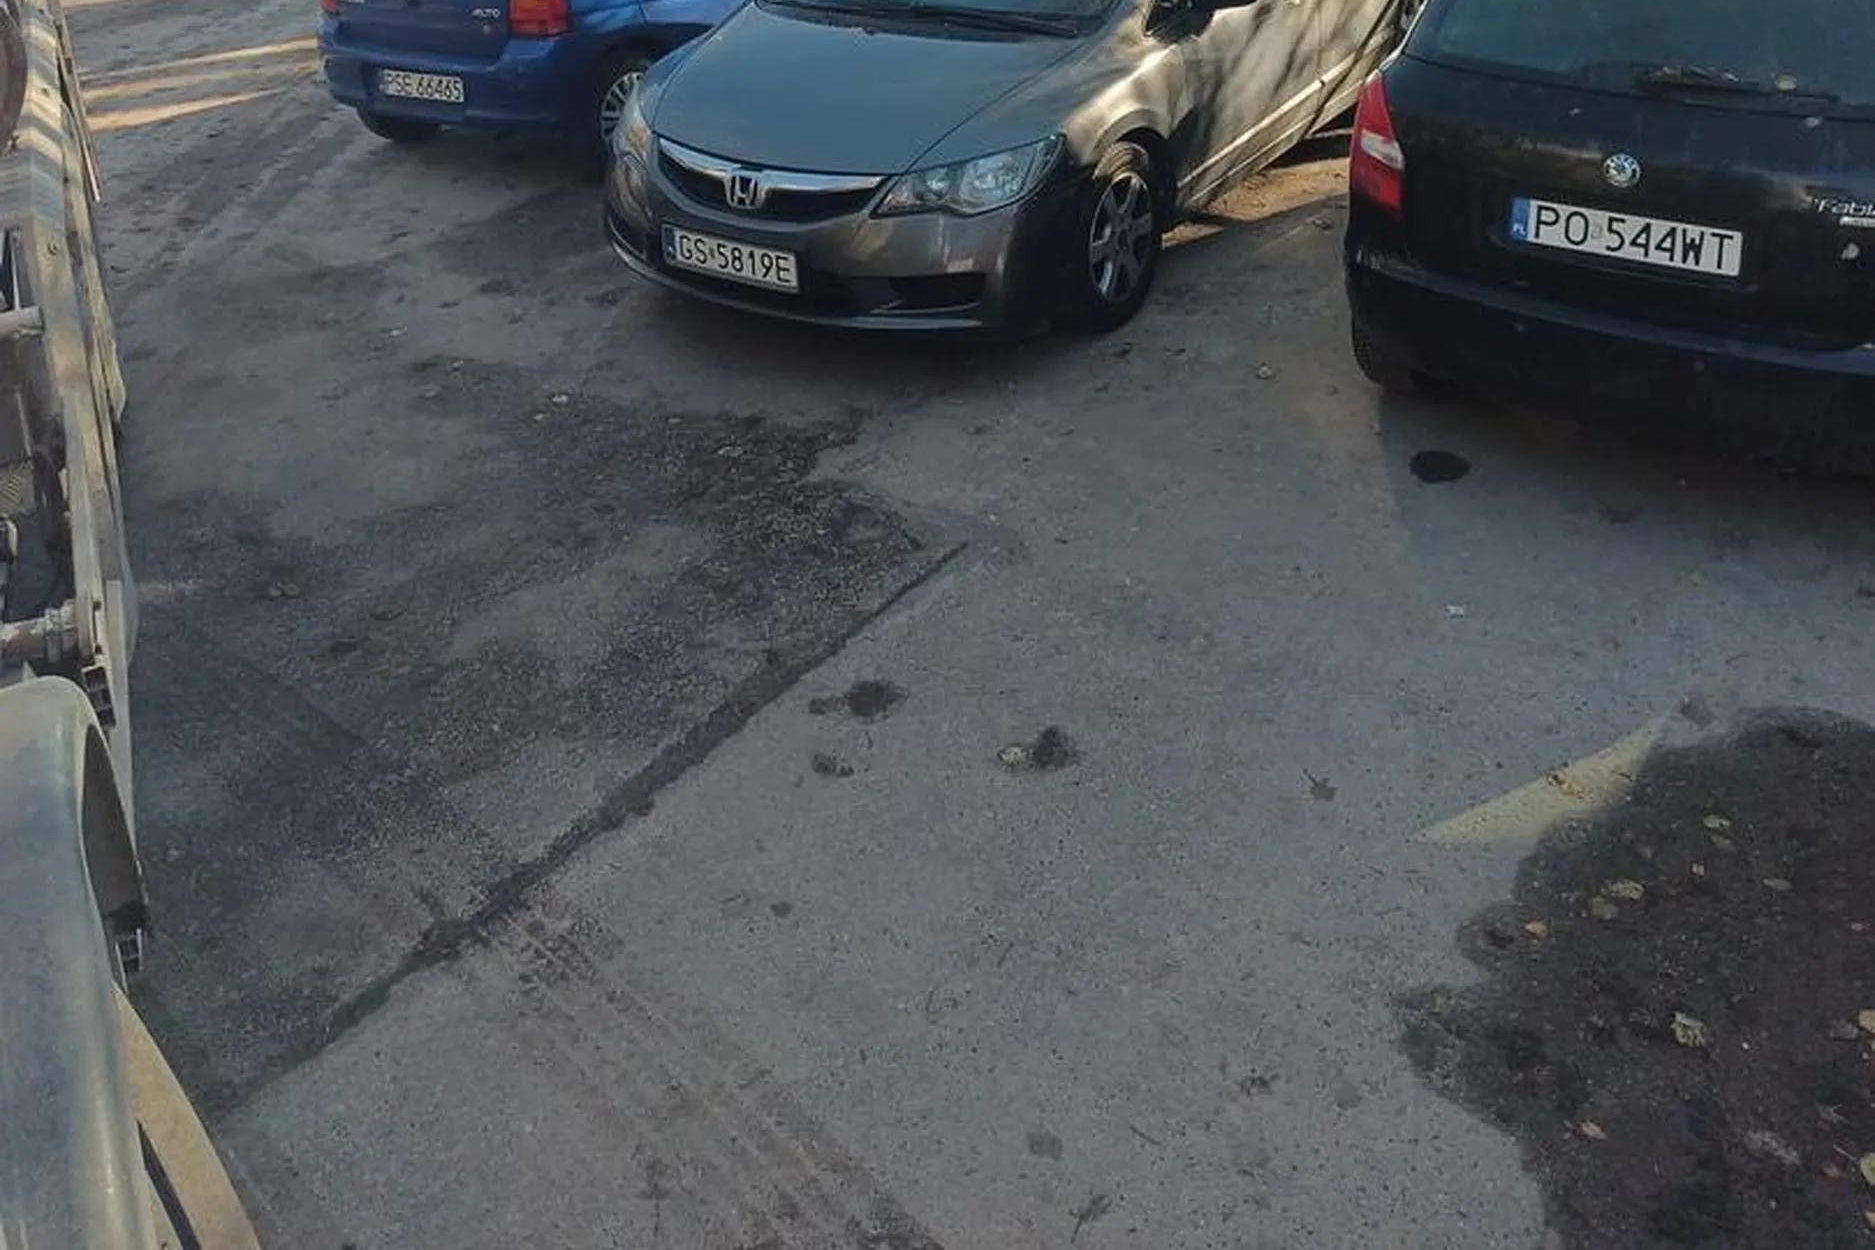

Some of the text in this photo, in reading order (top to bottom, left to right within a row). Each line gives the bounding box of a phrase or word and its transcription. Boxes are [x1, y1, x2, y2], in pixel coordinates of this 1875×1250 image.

[415, 75, 463, 101] 66465
[679, 234, 708, 265] GS
[716, 242, 792, 284] 5819E
[1534, 204, 1590, 247] PO
[1605, 216, 1735, 271] 544WT
